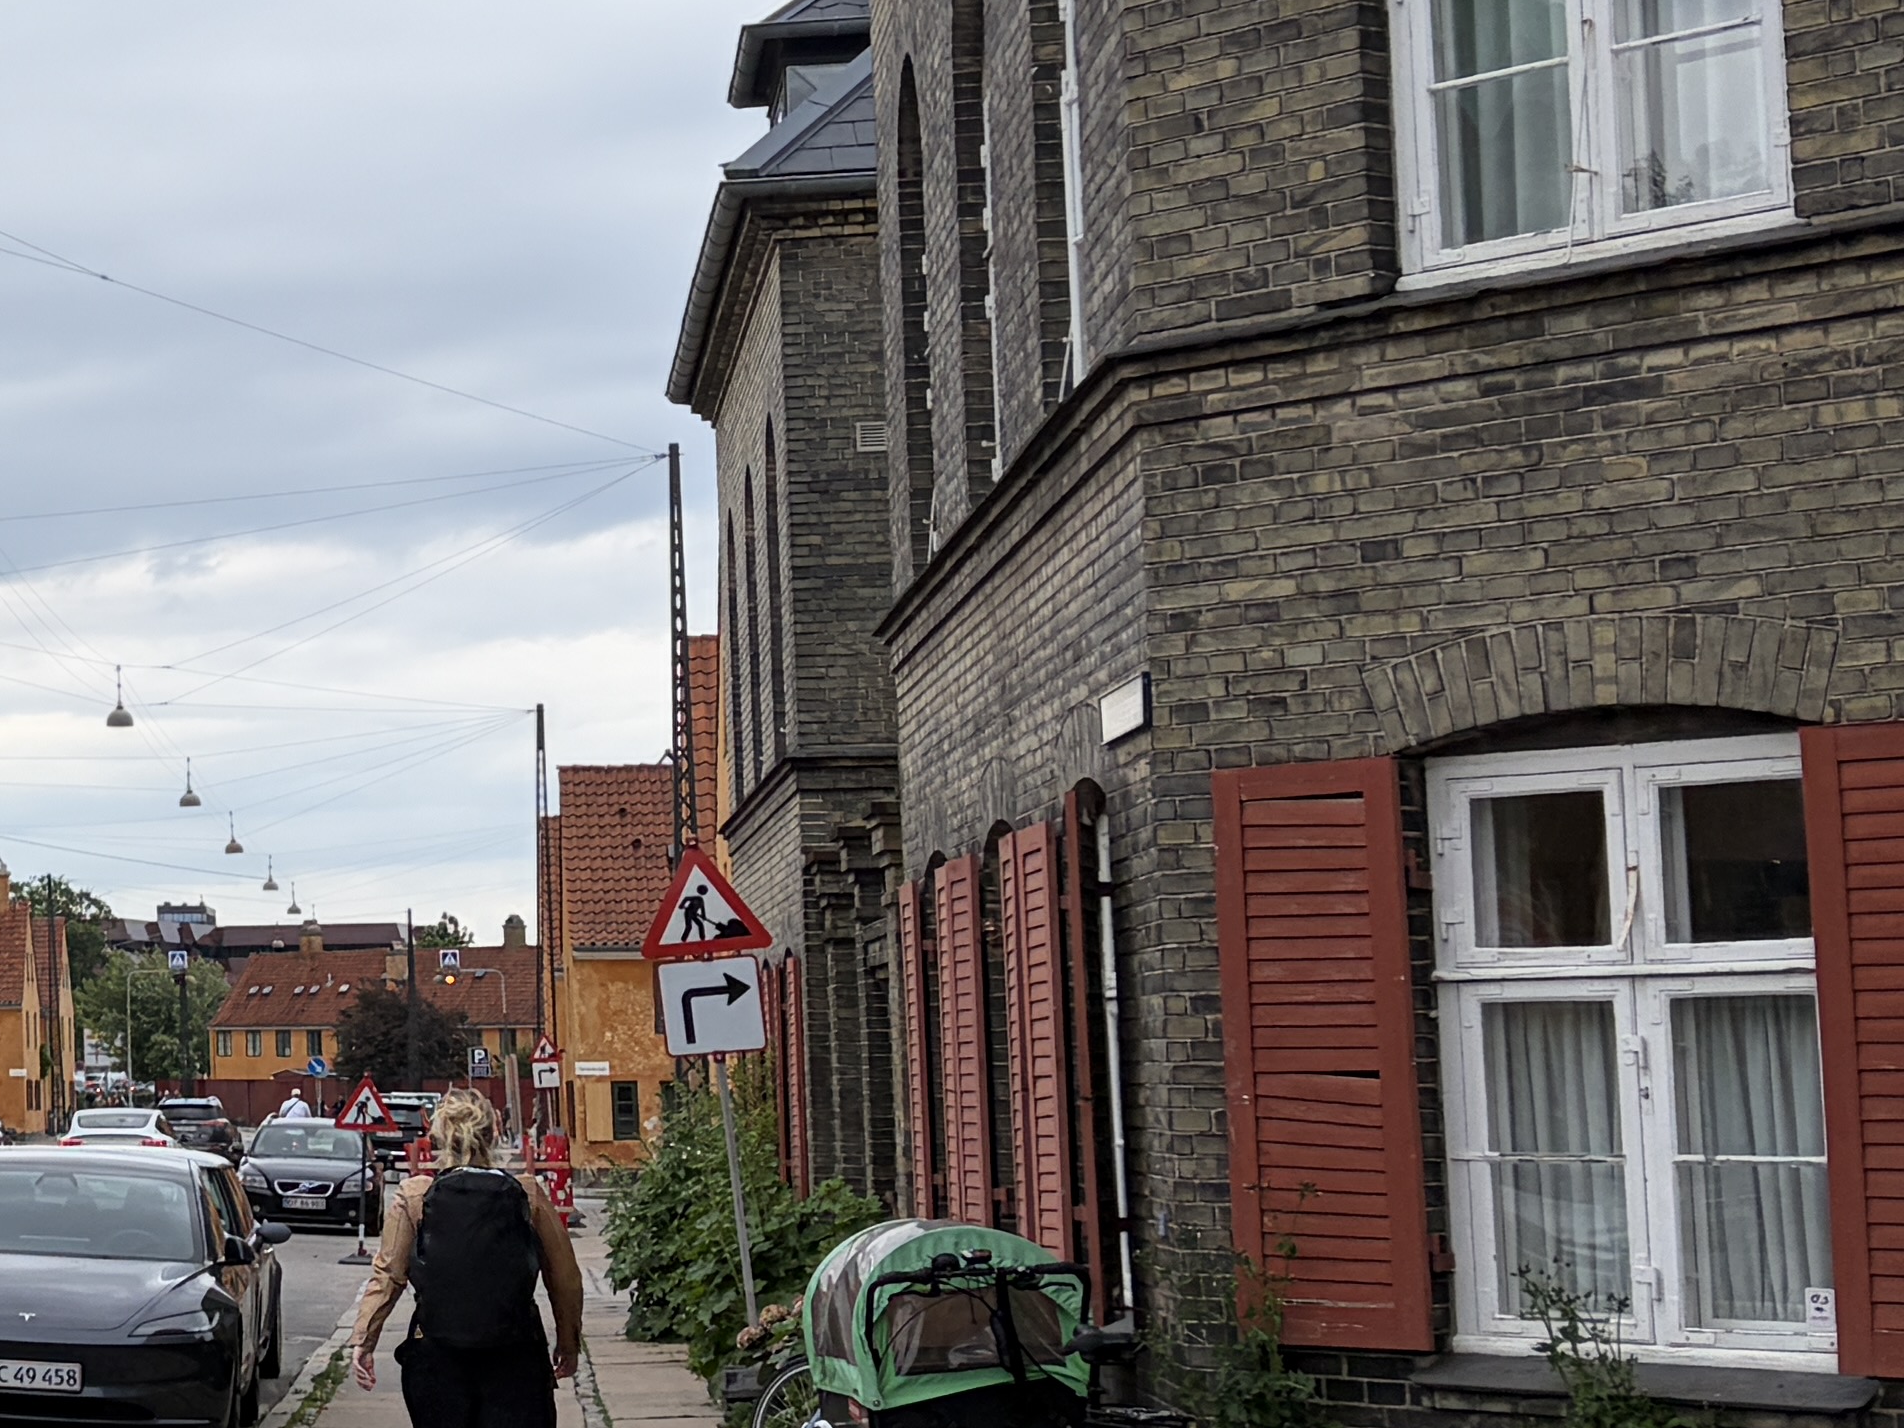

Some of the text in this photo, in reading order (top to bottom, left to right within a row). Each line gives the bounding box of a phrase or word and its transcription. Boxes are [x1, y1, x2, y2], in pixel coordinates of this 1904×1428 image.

[474, 1049, 486, 1063] P
[13, 1366, 36, 1384] 49
[42, 1368, 77, 1387] 458
